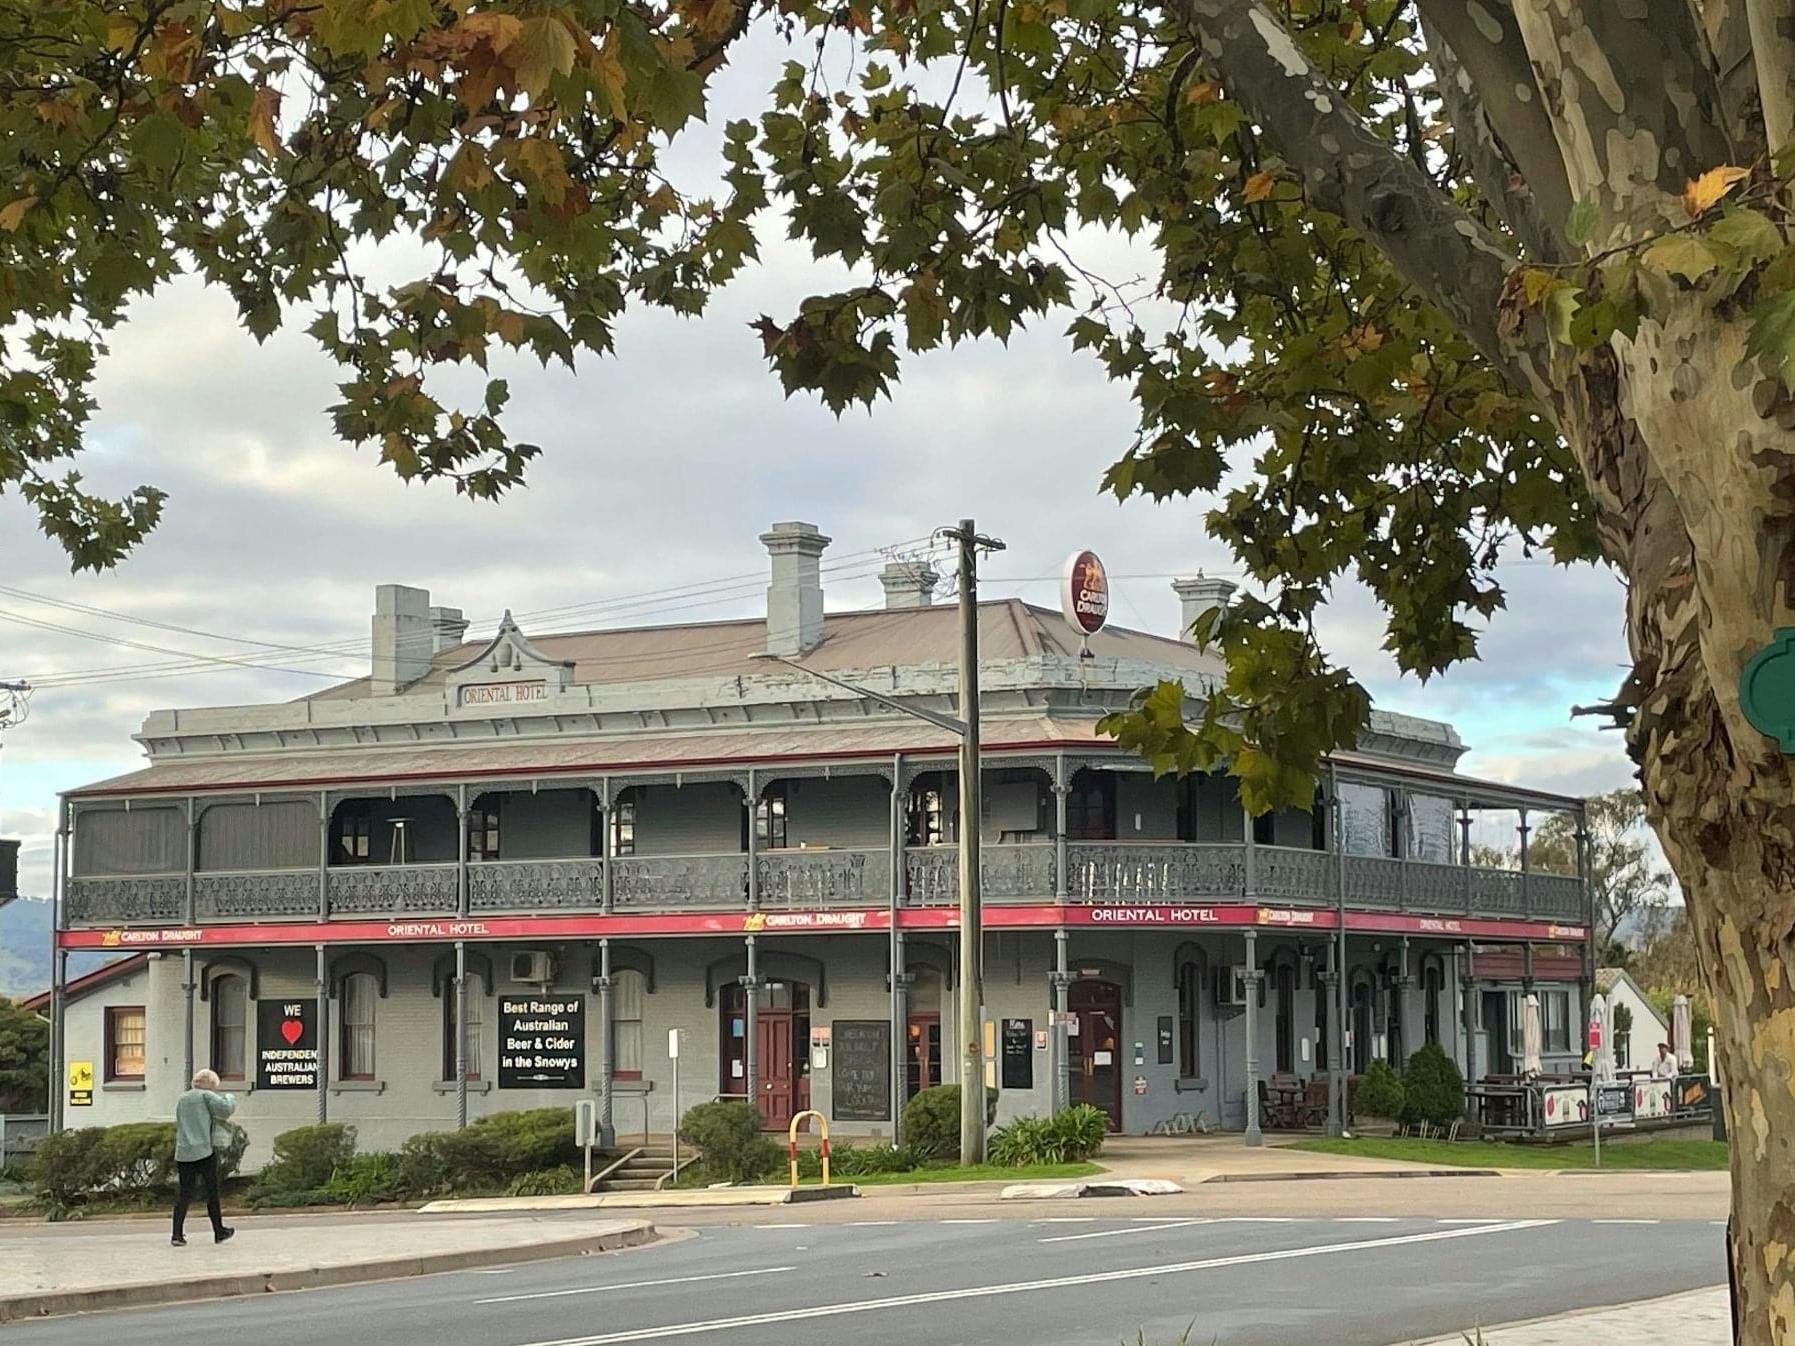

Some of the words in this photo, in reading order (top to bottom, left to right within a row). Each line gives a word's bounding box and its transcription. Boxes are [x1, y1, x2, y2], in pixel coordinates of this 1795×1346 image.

[1080, 589, 1105, 604] CARLT
[1076, 600, 1106, 616] DRAUG
[464, 685, 511, 704] ORIENTAL
[515, 684, 548, 701] HOTEL
[765, 914, 812, 926] CARLTON
[815, 912, 866, 926] DRAUGHT
[1091, 909, 1165, 921] ORIENTAL
[1170, 909, 1219, 921] HOTEL
[162, 930, 203, 941] DRAUGHT
[387, 924, 445, 936] ORIENTAL
[449, 923, 490, 935] HOTEL
[283, 1004, 302, 1017] WE
[503, 1001, 528, 1014] Best
[530, 1001, 565, 1016] Range
[567, 1000, 579, 1013] of
[513, 1019, 569, 1032] Australian
[506, 1037, 533, 1050] Beer
[534, 1037, 543, 1050] &
[545, 1036, 575, 1050] Cider
[261, 1049, 318, 1060] INDEPENDEN
[264, 1061, 318, 1073] AUSTRALIAN
[502, 1055, 513, 1068] in
[514, 1055, 533, 1068] the
[534, 1055, 578, 1071] Snowys
[270, 1074, 314, 1085] BREWERS
